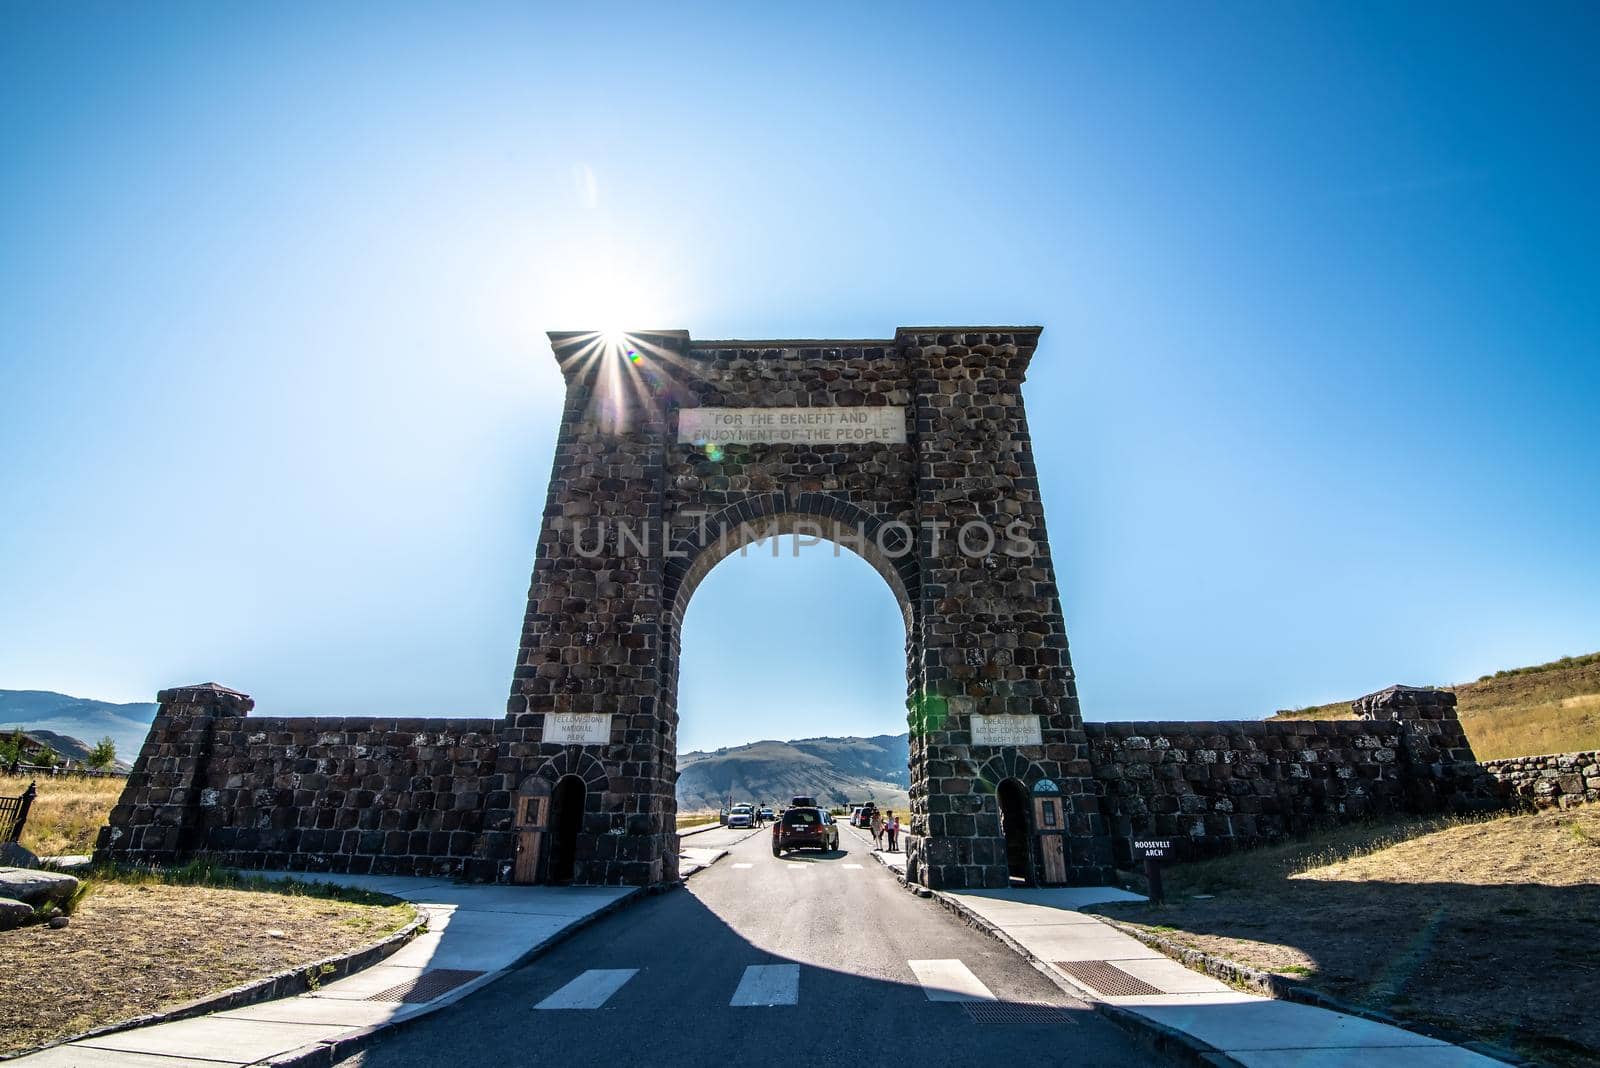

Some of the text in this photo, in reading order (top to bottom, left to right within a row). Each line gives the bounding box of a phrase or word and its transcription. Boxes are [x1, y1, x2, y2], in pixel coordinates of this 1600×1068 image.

[751, 413, 774, 425] THE
[781, 413, 836, 425] BENEFIT
[840, 412, 868, 424] AND
[694, 427, 897, 441] ENJOYMENT OF THE PEOPLE"
[566, 734, 585, 742] PARK
[1134, 841, 1170, 849] ROOSEVELT
[1145, 849, 1164, 857] ARCH
